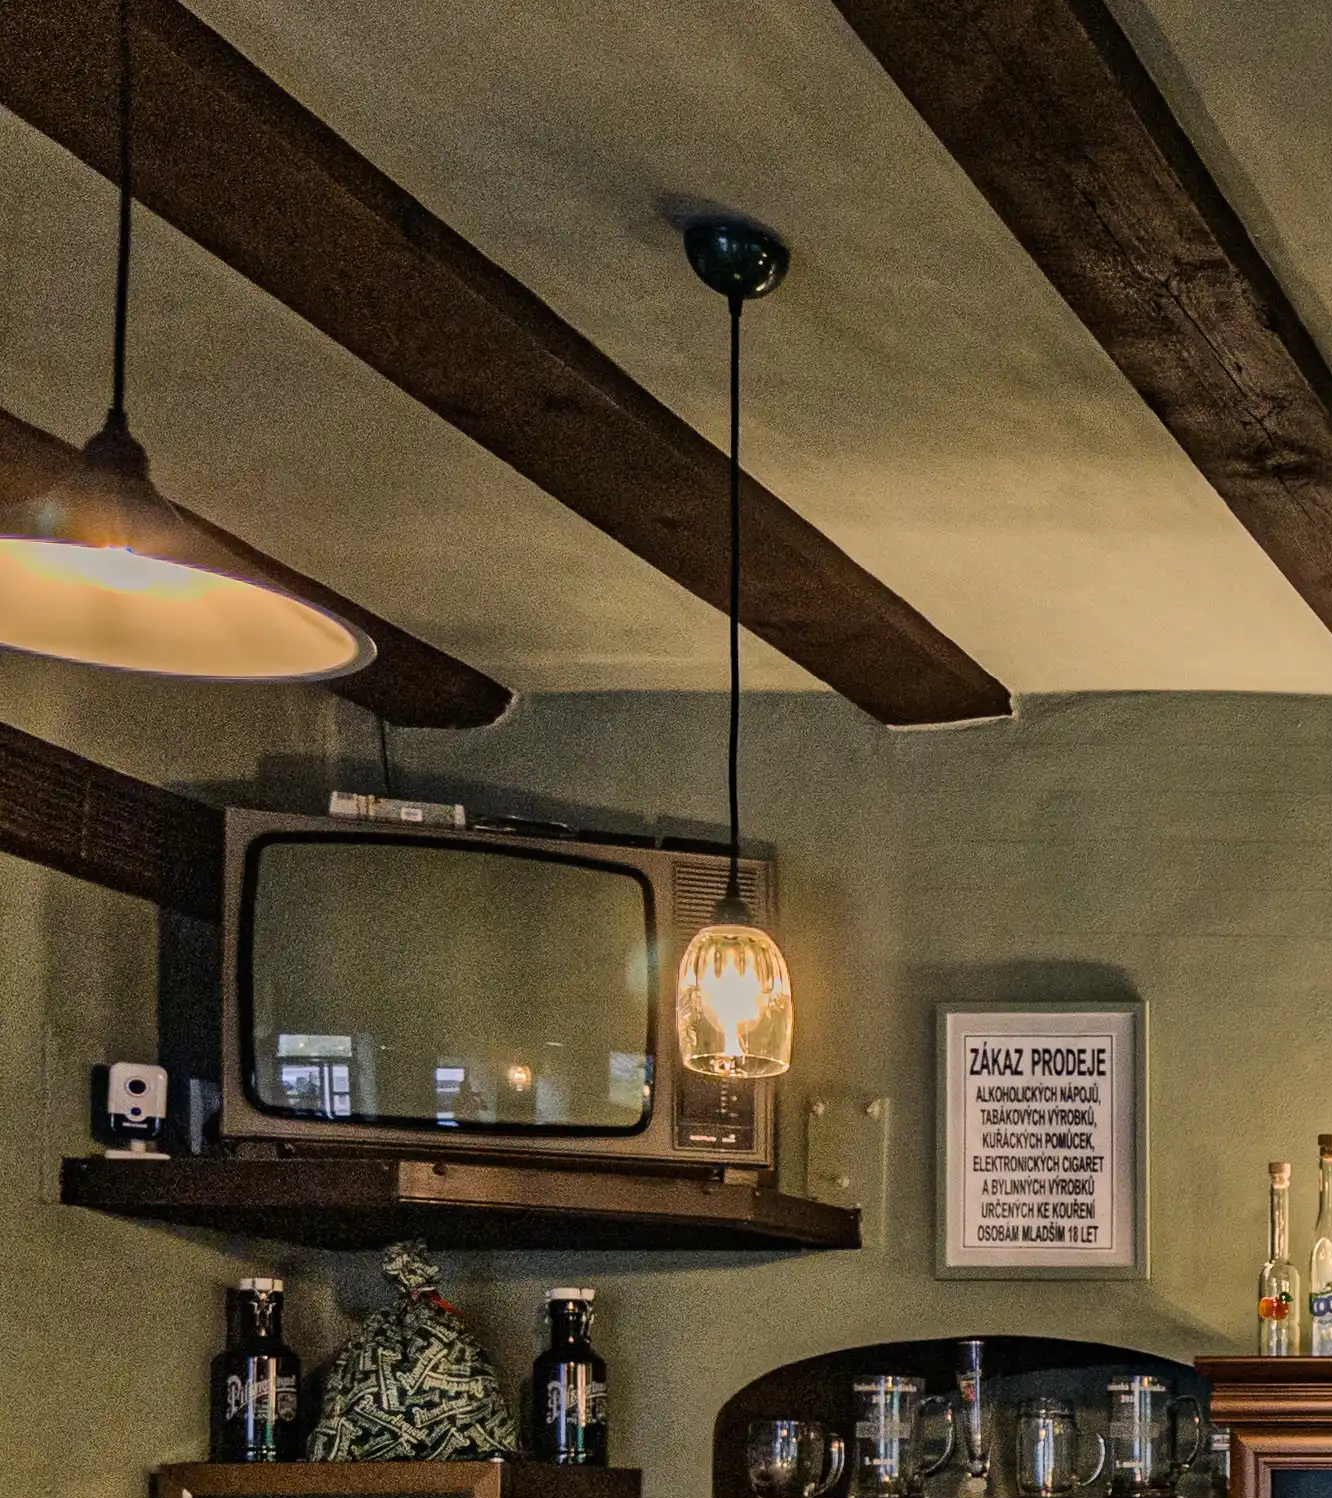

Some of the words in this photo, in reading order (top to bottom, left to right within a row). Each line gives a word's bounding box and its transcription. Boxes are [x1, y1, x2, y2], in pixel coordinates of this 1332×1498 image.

[969, 1041, 1024, 1076] ZÁKAZ
[1031, 1048, 1107, 1076] PRODEJE
[976, 1083, 1058, 1102] ALKOHOLICKÝCH
[981, 1106, 1045, 1126] TABÁKOVÝCH
[982, 1128, 1043, 1150] KUŘÁCKÝCH
[973, 1152, 1060, 1173] ELEKTRONICKÝCH
[1062, 1156, 1105, 1173] CIGARET
[982, 1180, 990, 1196] A
[991, 1176, 1046, 1196] BYLINNÝCH
[1048, 1175, 1095, 1196] VÝROBKŮ
[981, 1199, 1035, 1219] URČENÝCH
[1037, 1202, 1050, 1218] KE
[1052, 1199, 1096, 1219] KOUŘENÍ
[977, 1222, 1020, 1243] OSOBÁM
[1022, 1221, 1066, 1243] MLADŠÍM
[1068, 1226, 1079, 1243] 18
[1081, 1226, 1099, 1243] LET
